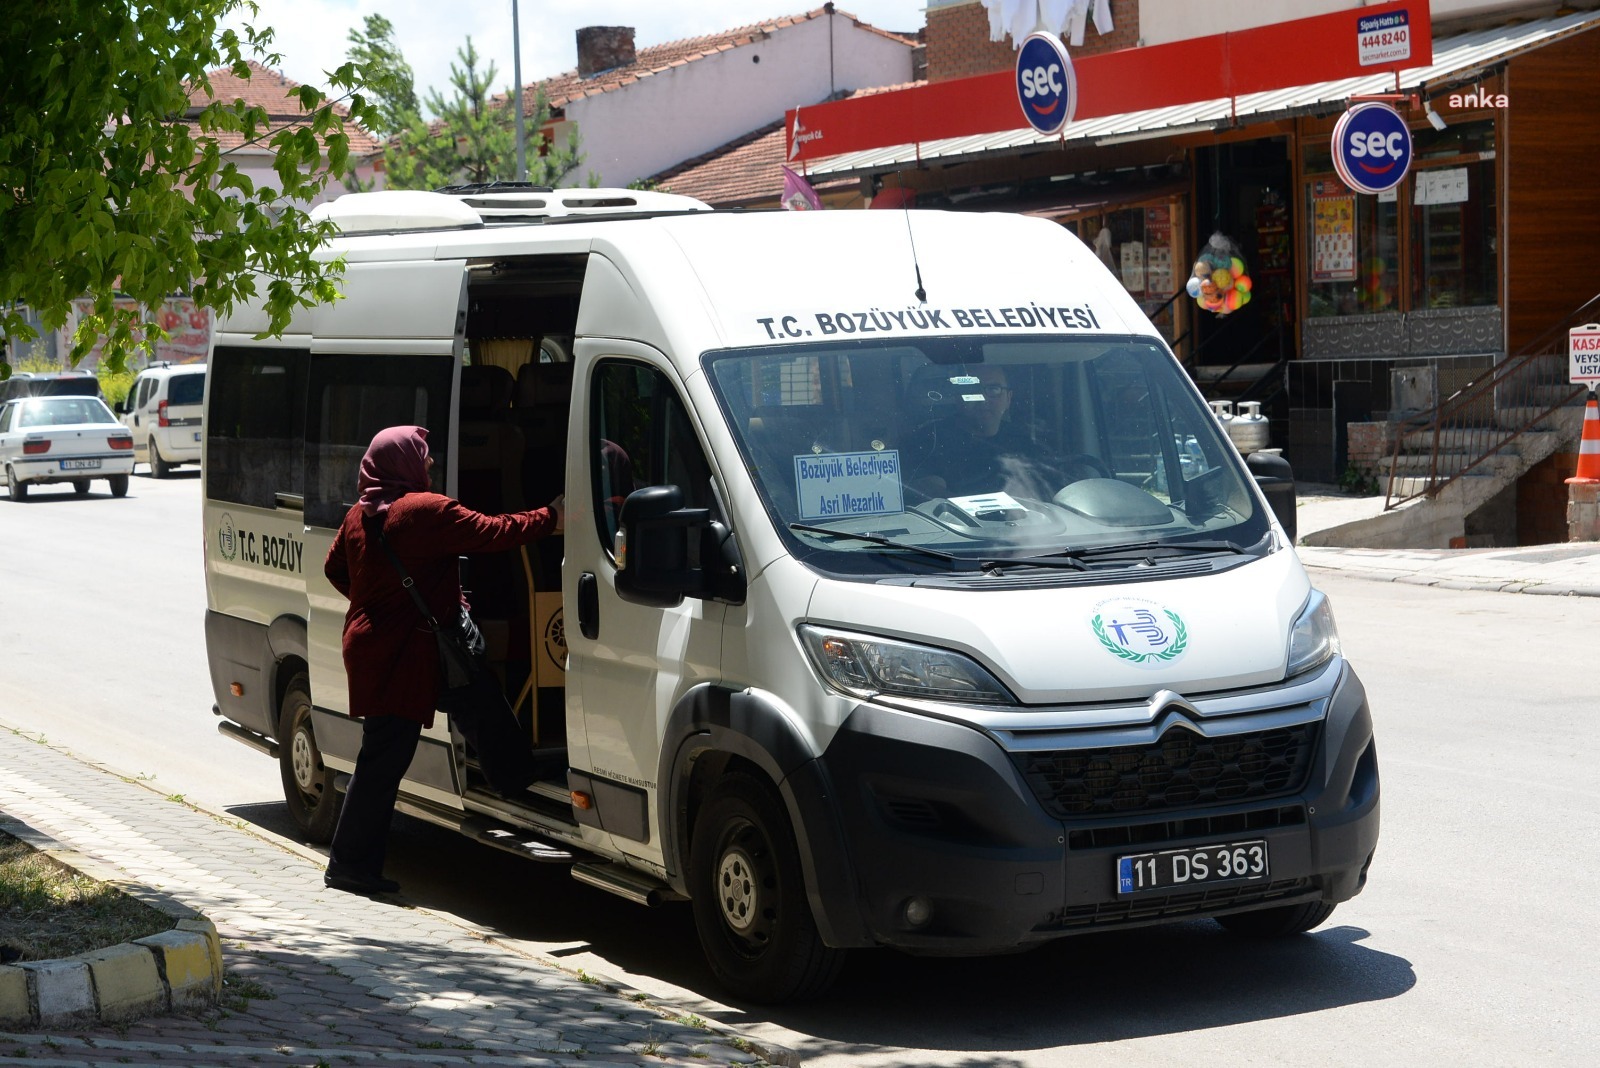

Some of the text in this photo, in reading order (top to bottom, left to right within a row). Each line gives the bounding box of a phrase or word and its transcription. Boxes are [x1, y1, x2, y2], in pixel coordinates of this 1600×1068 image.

[1021, 63, 1062, 98] seç
[1350, 131, 1403, 160] seç
[757, 301, 1101, 340] T.C. BOZÜYÜK BELEDİYESİ
[800, 455, 897, 483] Bozüyük Belediyesi
[820, 491, 885, 515] Asri Mezarlık
[239, 530, 303, 573] T.C. BOZÜY
[1121, 846, 1264, 887] TR 11 DS 363
